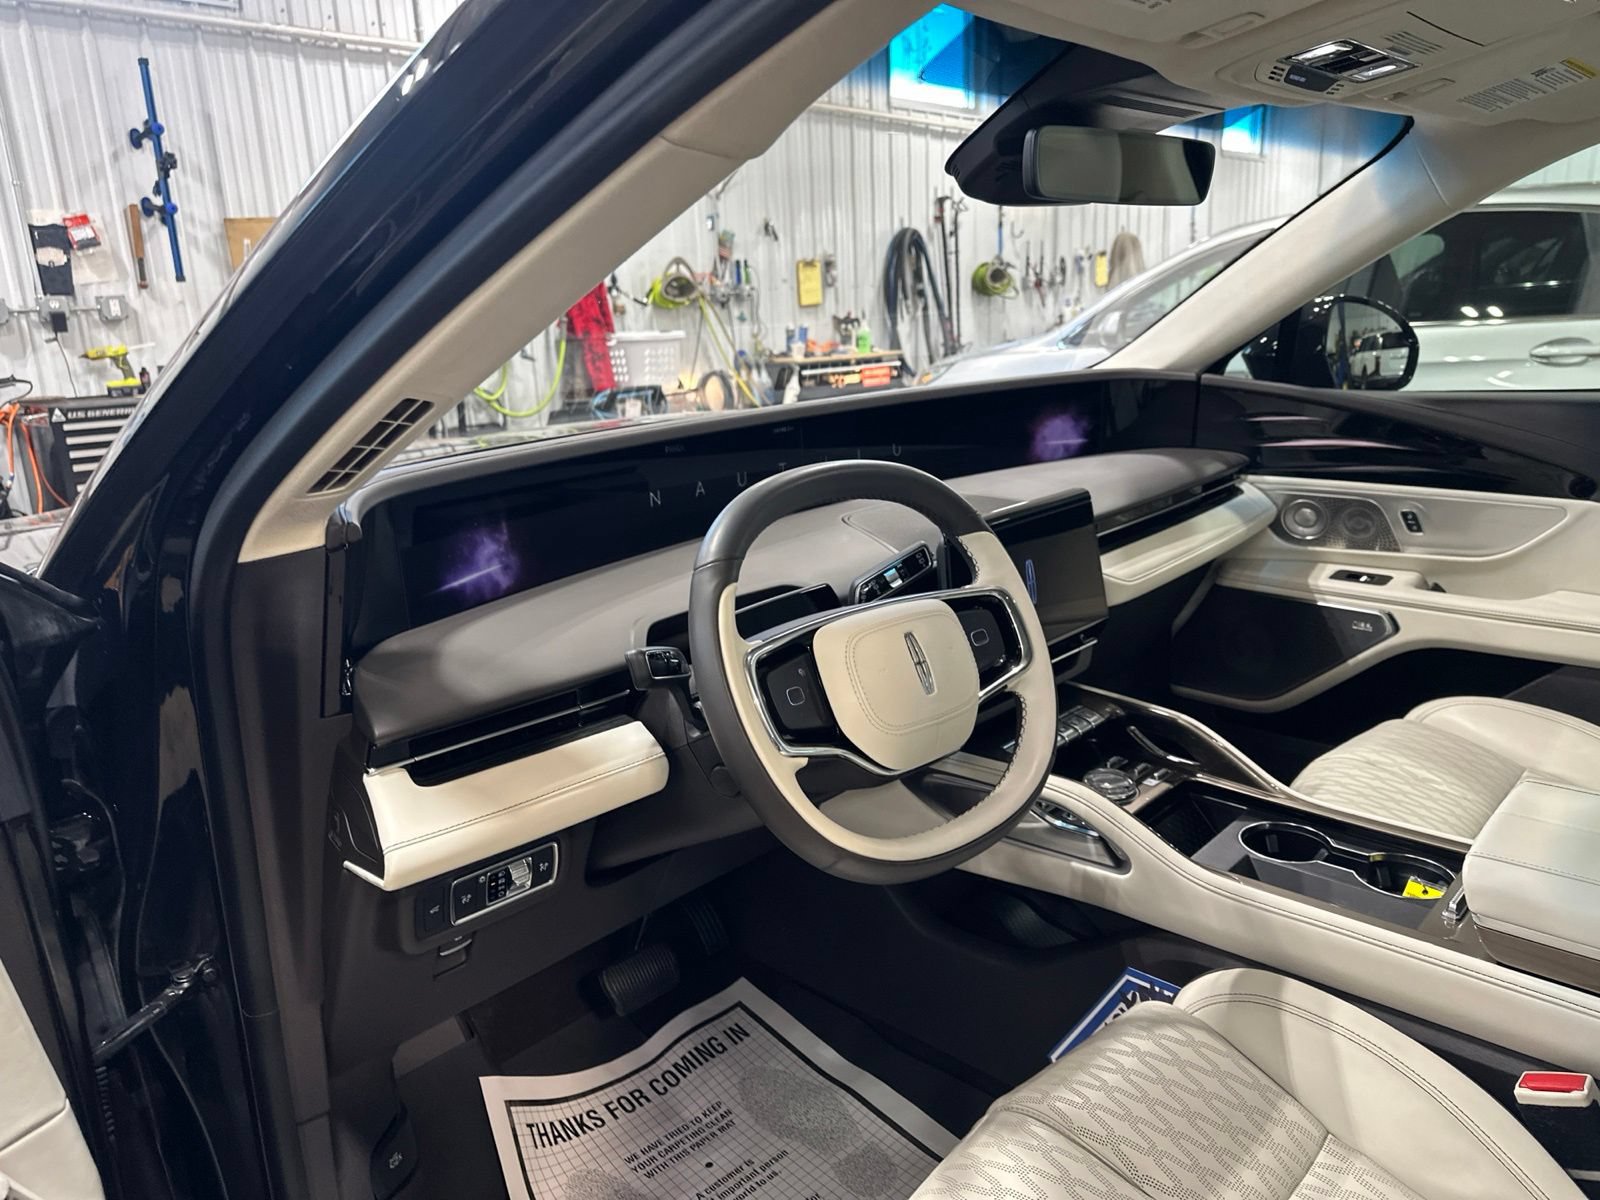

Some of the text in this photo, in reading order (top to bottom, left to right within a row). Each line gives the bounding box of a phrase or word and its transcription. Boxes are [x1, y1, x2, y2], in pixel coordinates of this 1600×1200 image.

[87, 407, 135, 418] GENERA
[526, 1023, 749, 1149] THANKS FOR COMING IN
[624, 1101, 723, 1166] WE HAVE TRIED TO KEEP
[630, 1109, 733, 1174] YOUR CARPETING CLEAN
[644, 1119, 736, 1179] WITH THIS PAPER MAT
[703, 1165, 745, 1195] customer
[744, 1158, 756, 1167] is
[716, 1149, 790, 1200] important person
[755, 1178, 767, 1187] to
